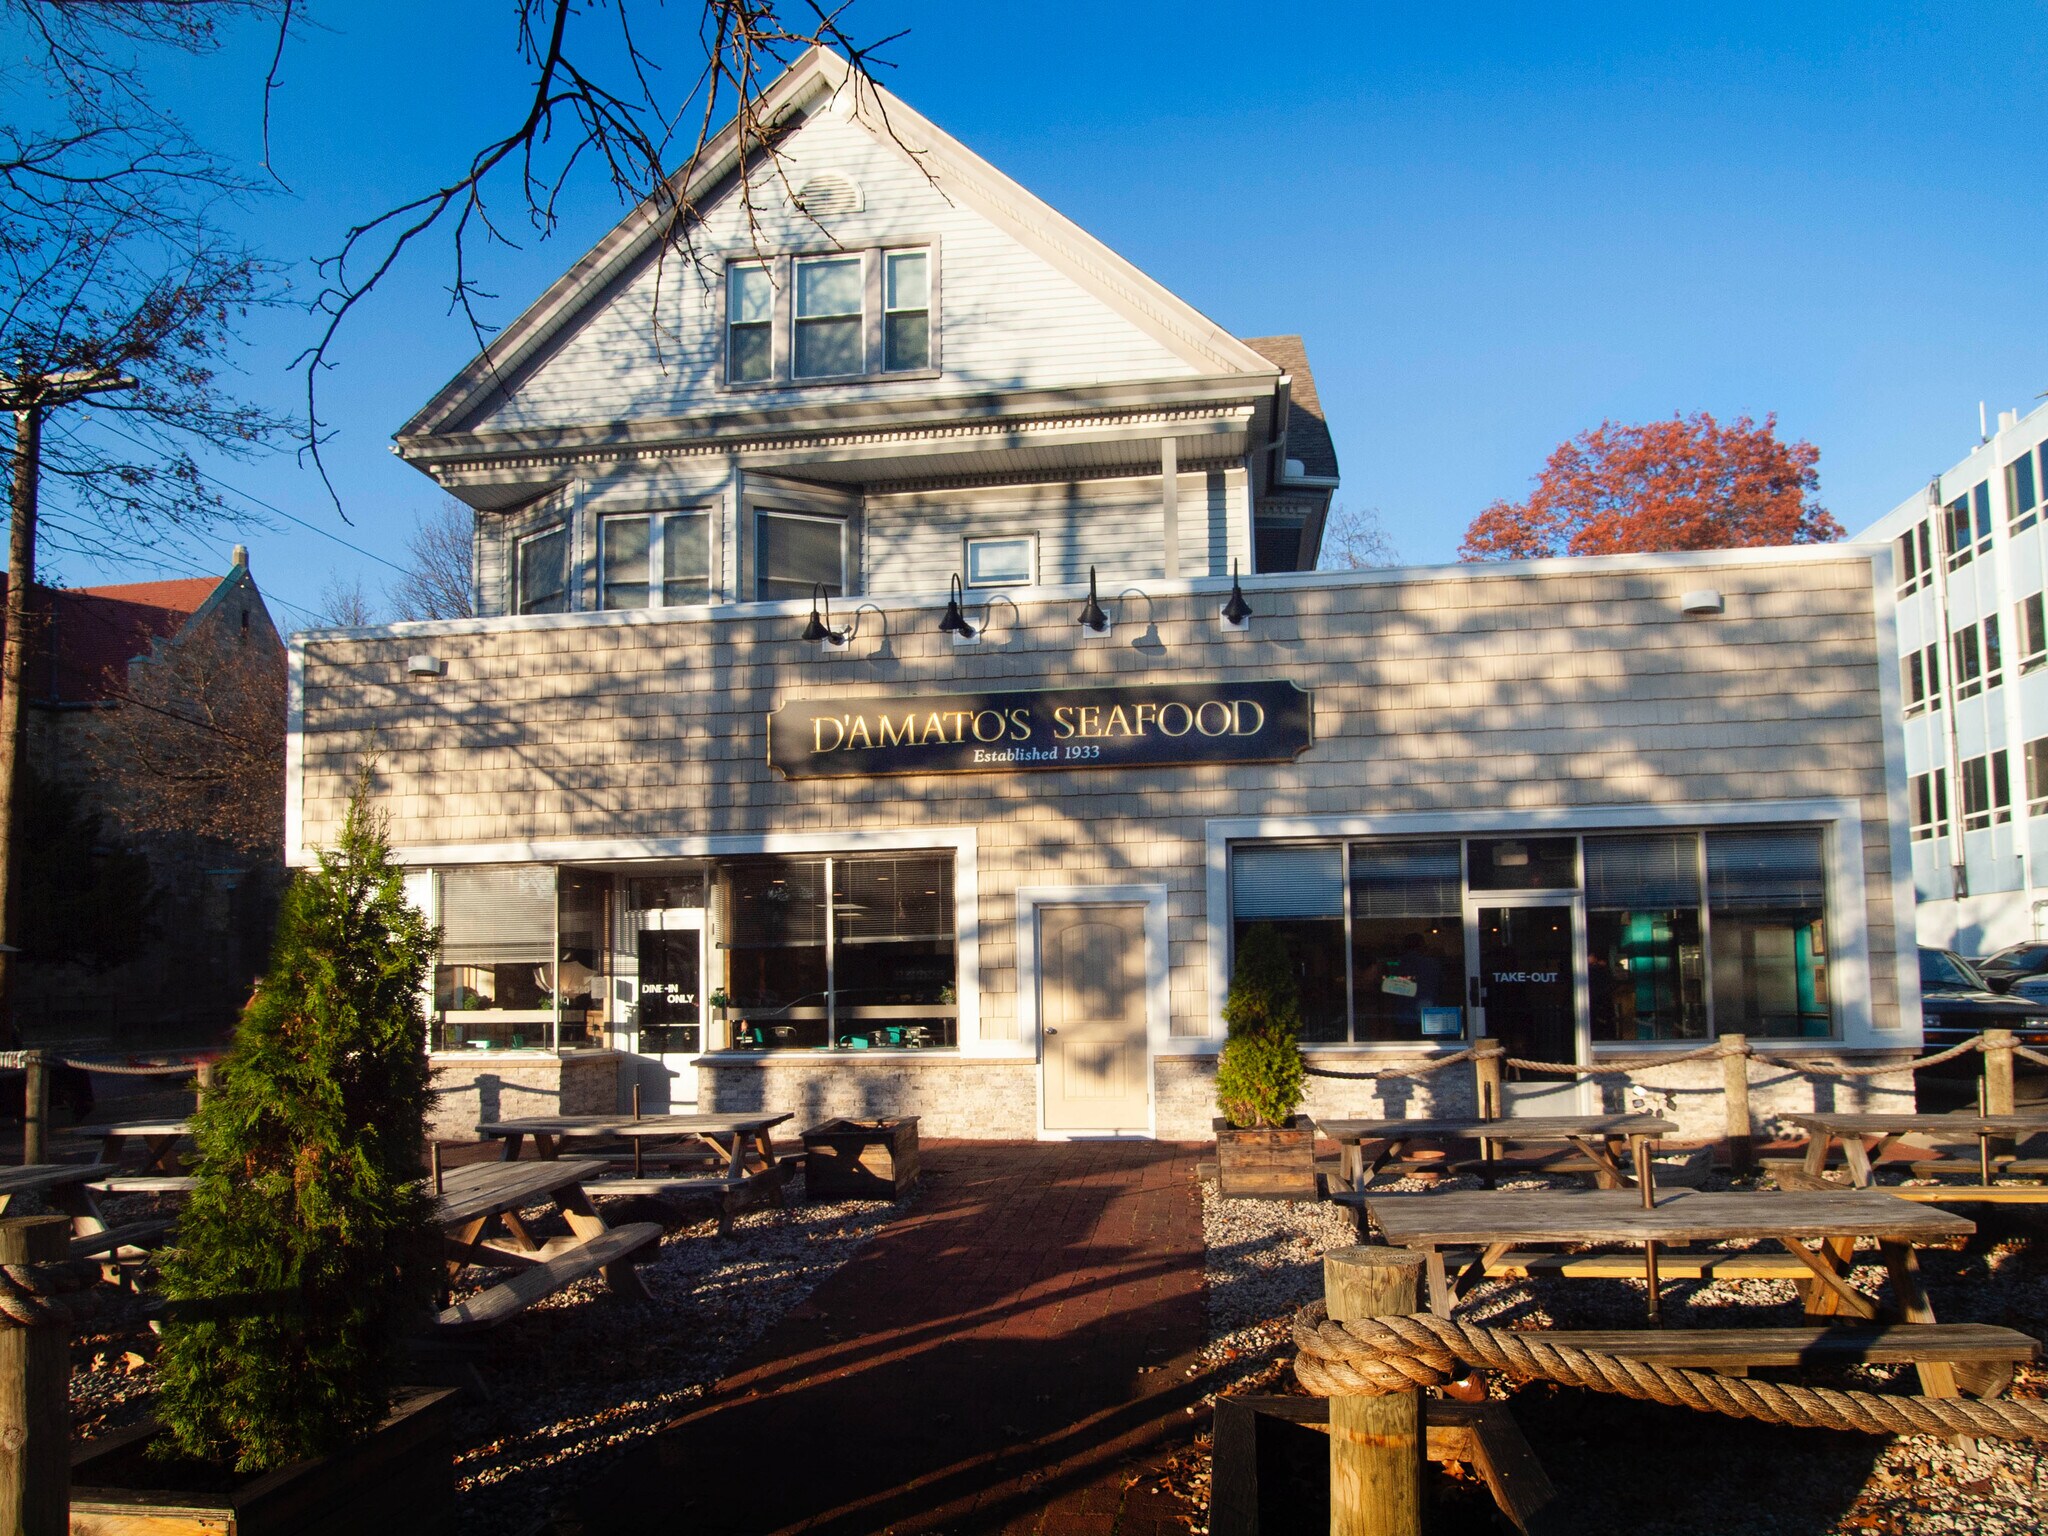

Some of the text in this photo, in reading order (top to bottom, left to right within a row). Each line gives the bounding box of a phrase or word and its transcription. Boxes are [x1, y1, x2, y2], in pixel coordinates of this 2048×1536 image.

[809, 700, 1265, 754] D'AMATO'S SEAFOOD
[973, 745, 1100, 763] Established 1933
[1492, 972, 1558, 982] TAKE-OUT
[642, 984, 678, 994] DINE-IN
[667, 994, 694, 1003] ONLY
